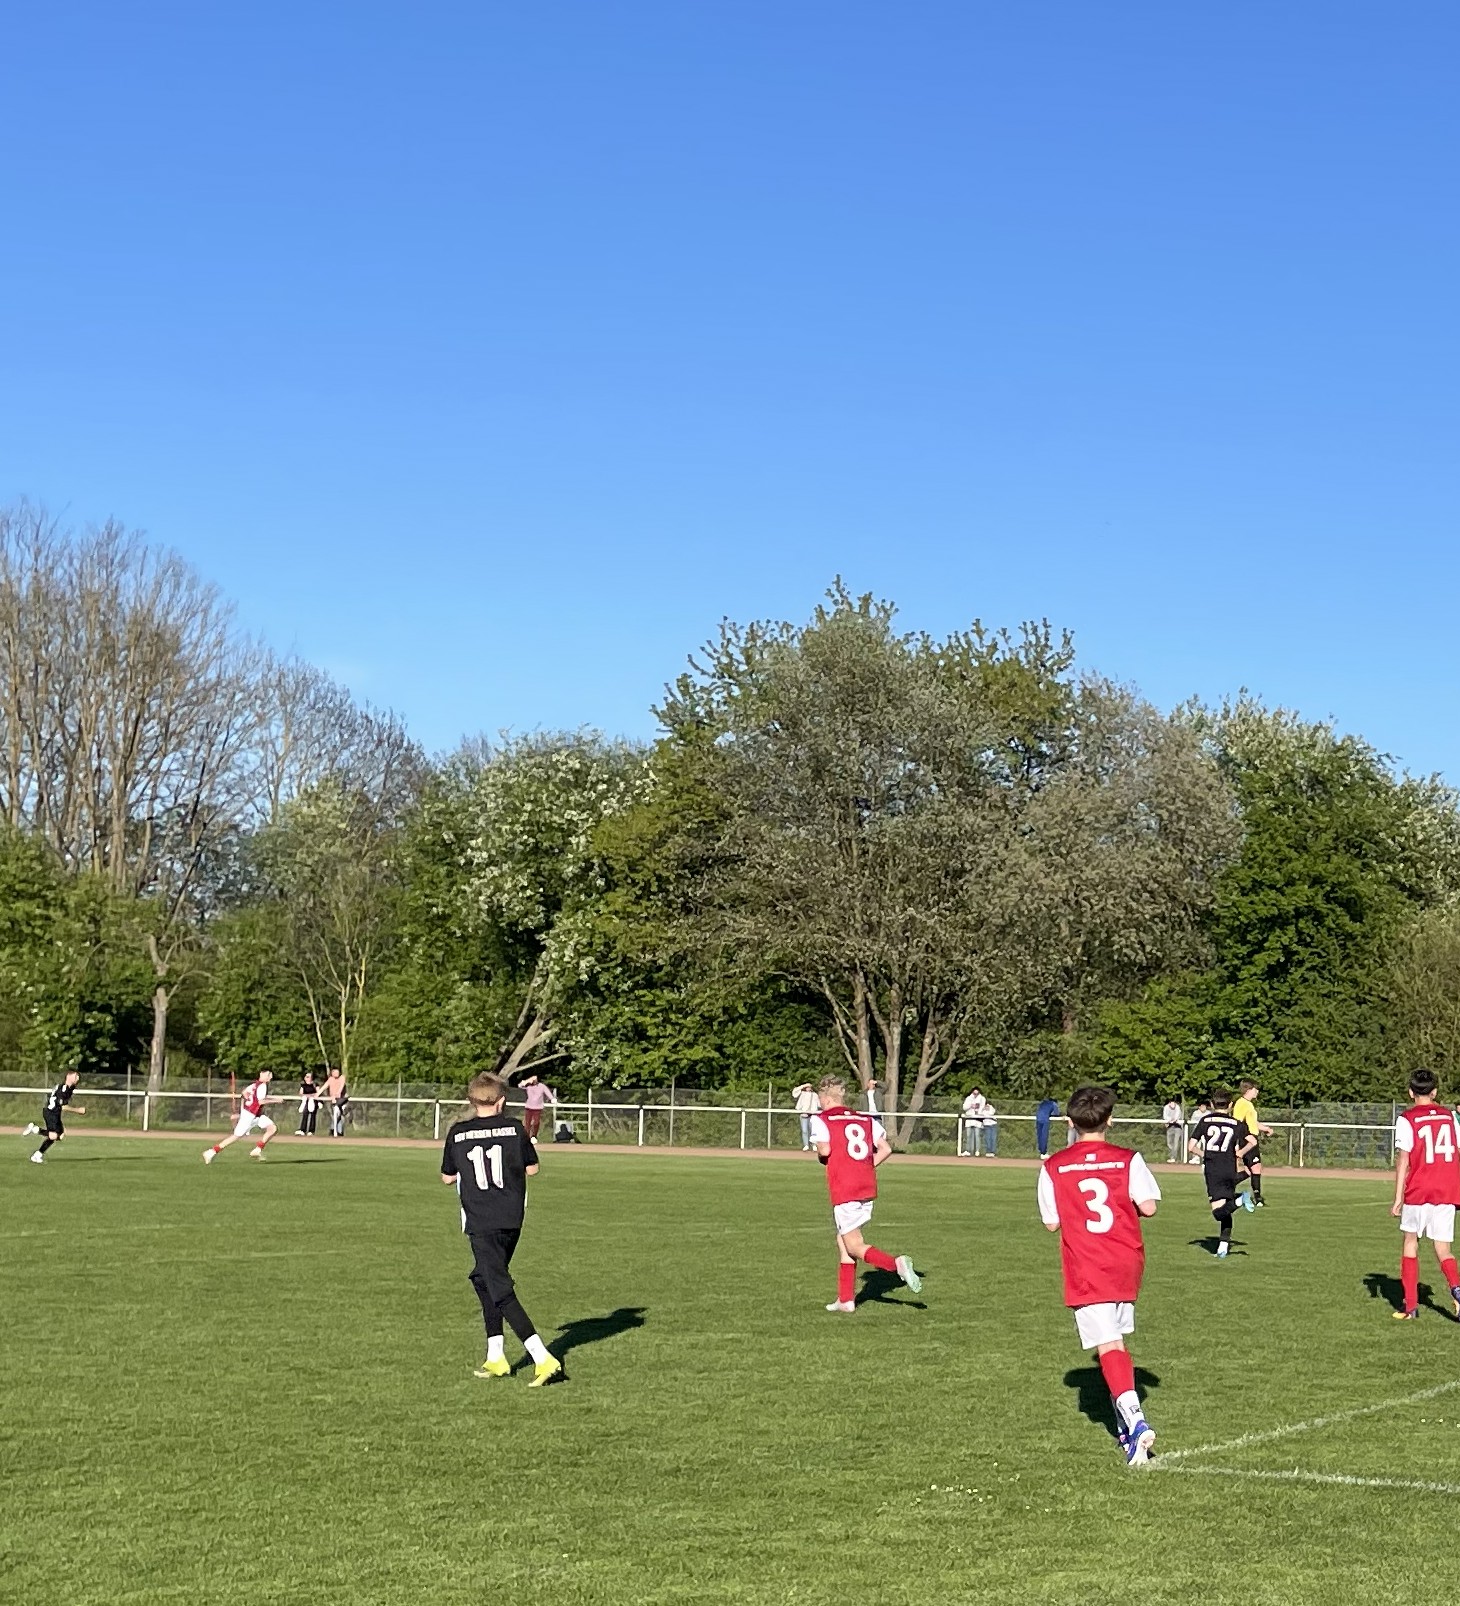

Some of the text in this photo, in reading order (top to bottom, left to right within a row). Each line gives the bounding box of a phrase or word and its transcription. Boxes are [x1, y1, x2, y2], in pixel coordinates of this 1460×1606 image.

[845, 1123, 869, 1161] 8
[1206, 1125, 1234, 1152] 27
[1417, 1123, 1456, 1164] 14
[467, 1145, 503, 1190] 11
[1077, 1177, 1114, 1234] 3
